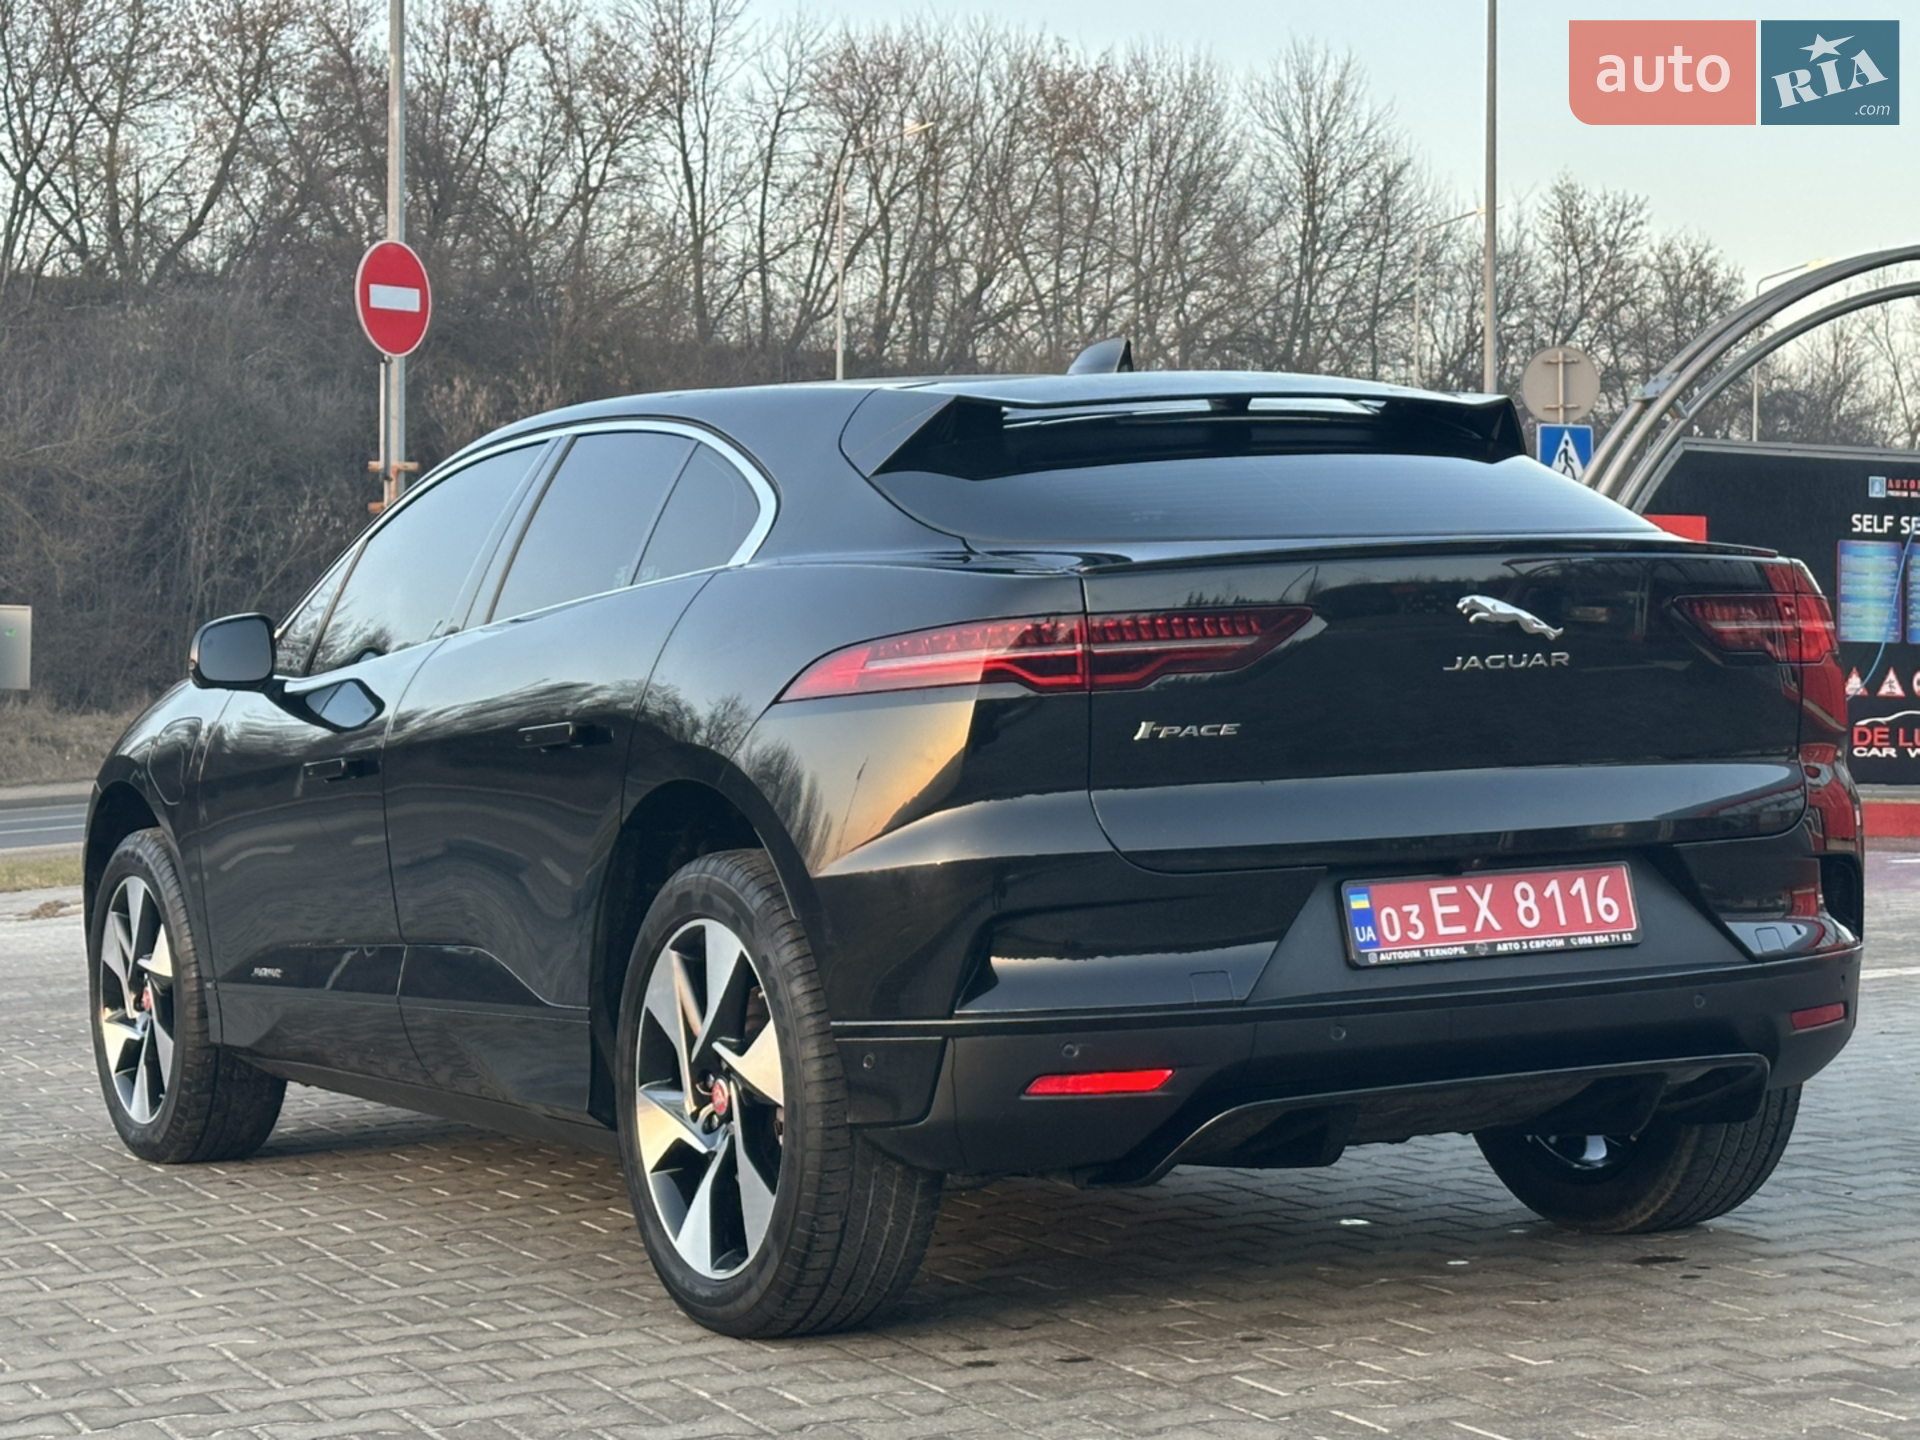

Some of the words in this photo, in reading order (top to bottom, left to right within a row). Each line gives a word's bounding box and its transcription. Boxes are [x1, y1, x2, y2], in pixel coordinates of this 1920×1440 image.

[1851, 513, 1894, 533] SELF
[1442, 651, 1570, 671] JAGUAR
[1852, 726, 1890, 746] DE
[1852, 746, 1897, 758] CAR
[1380, 903, 1425, 942] 03
[1429, 883, 1501, 935] EX
[1513, 874, 1620, 929] 8116
[1354, 925, 1377, 943] UA
